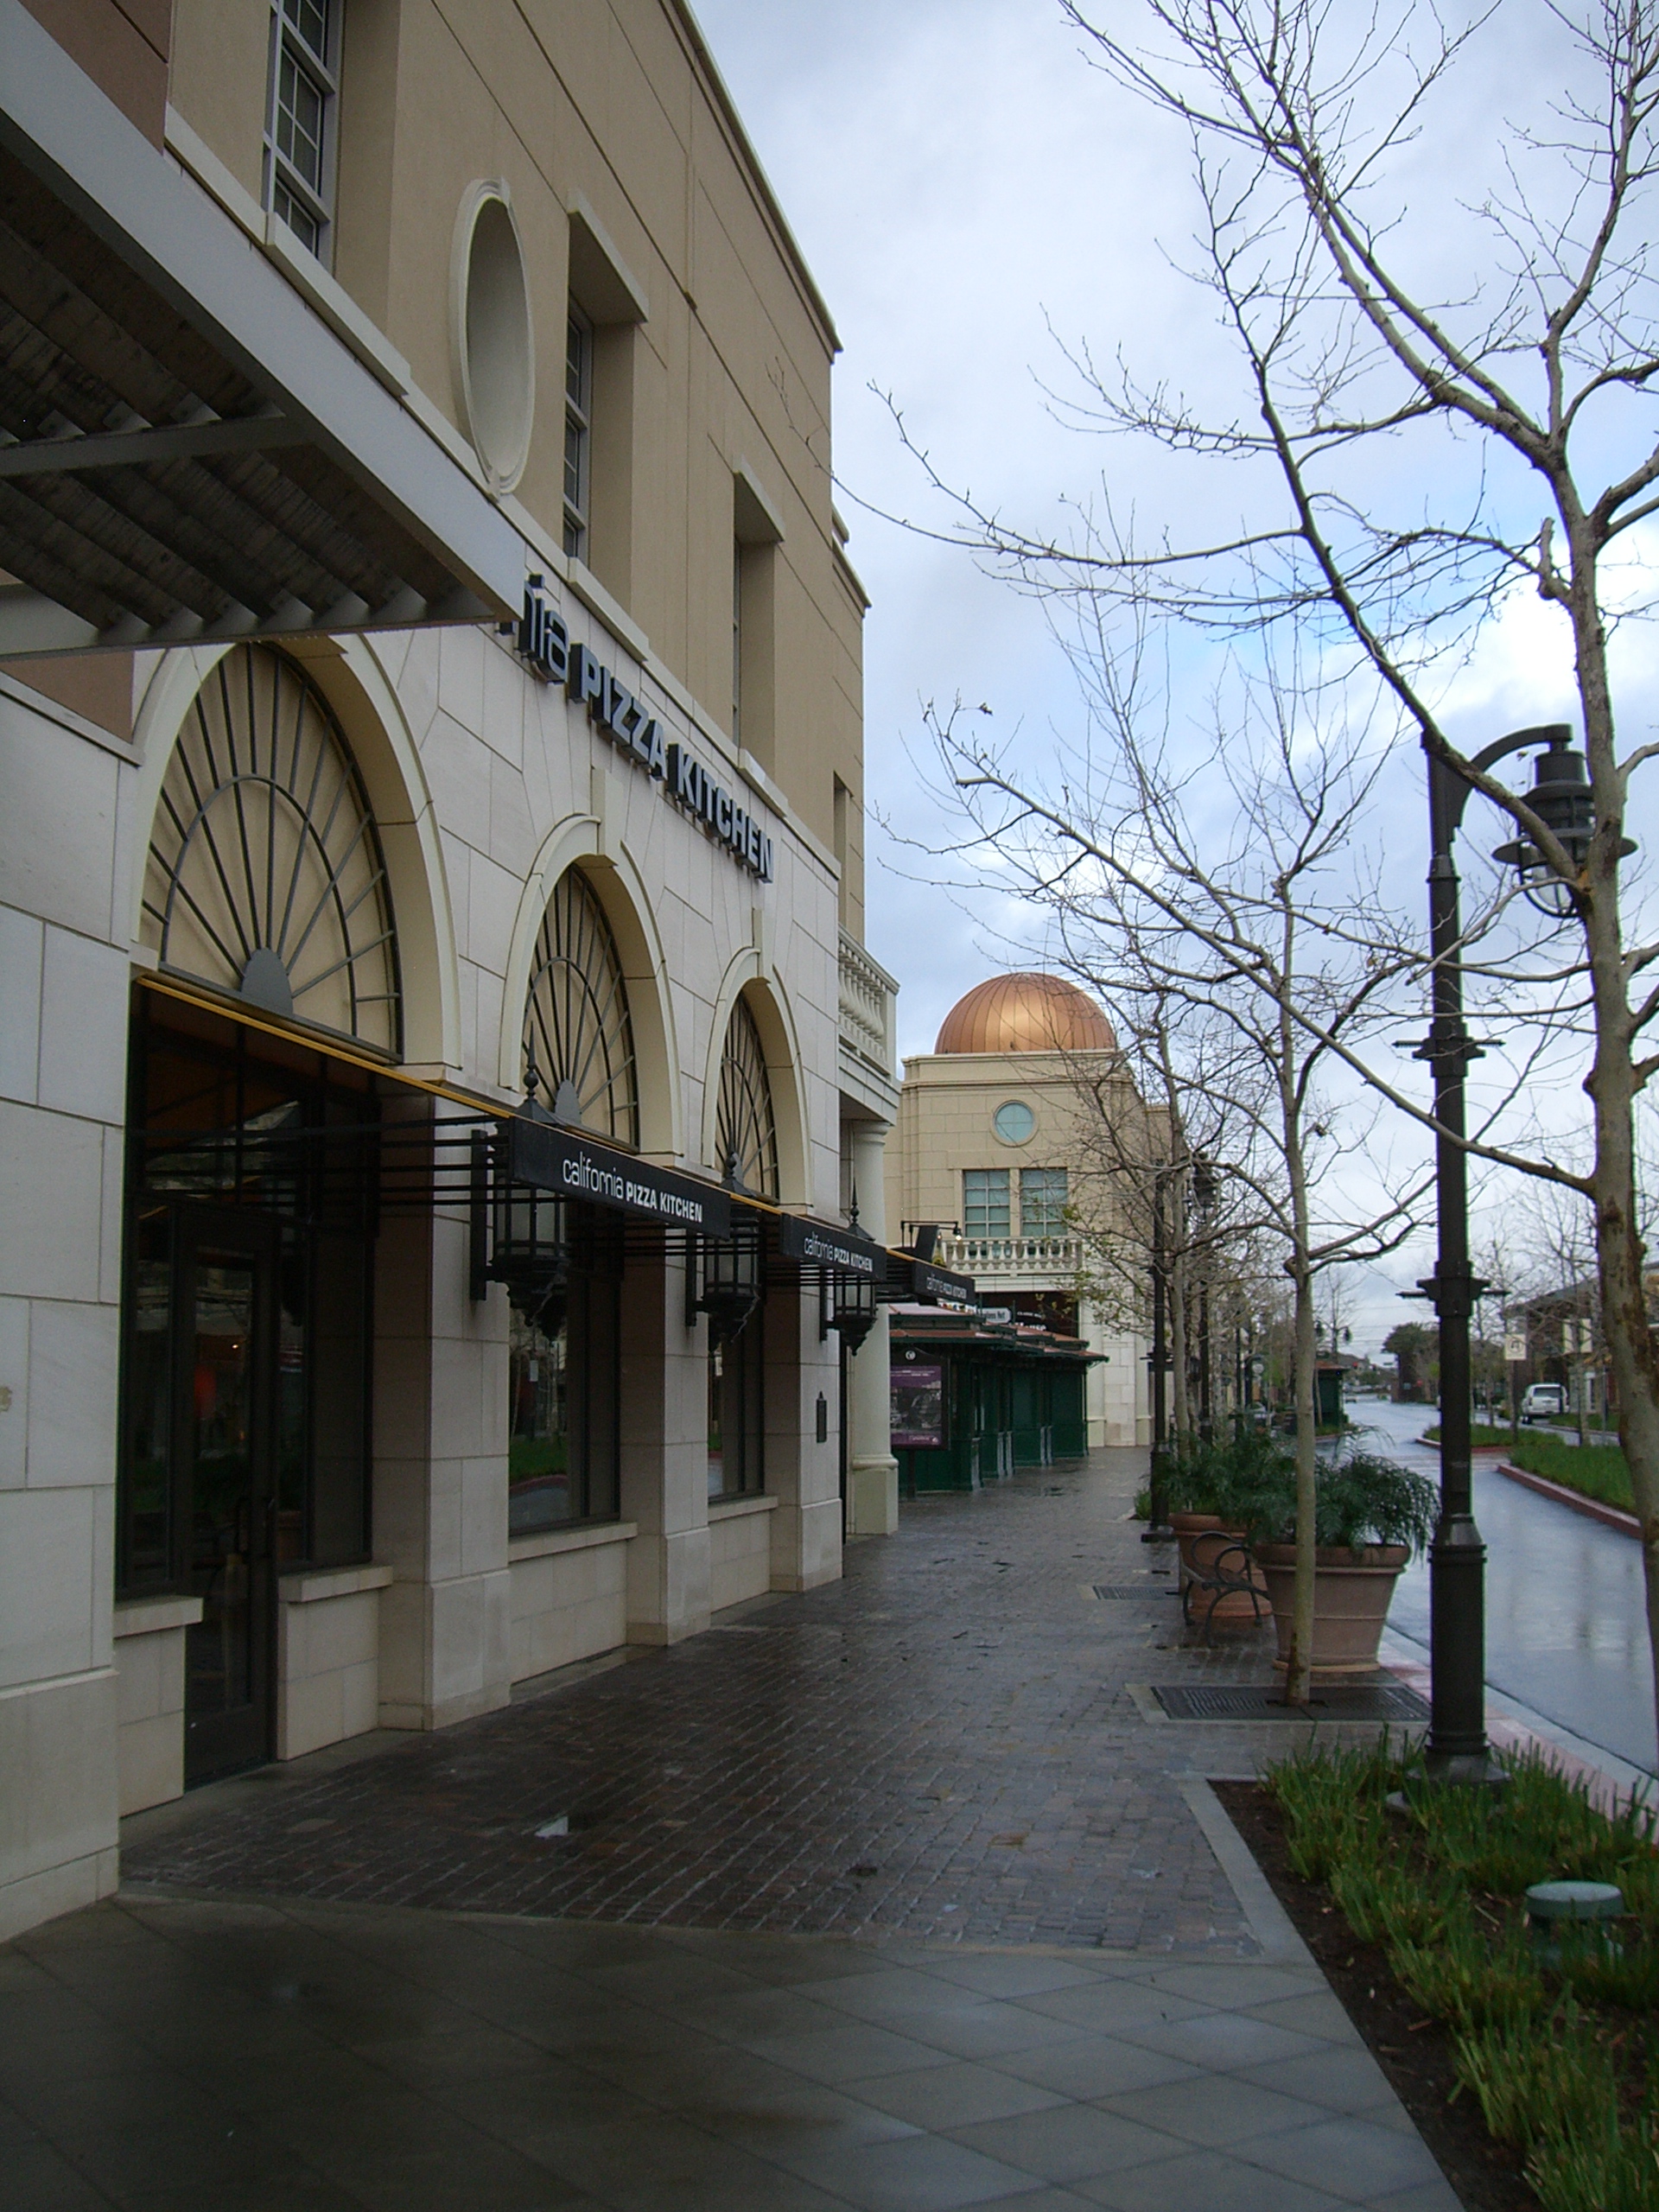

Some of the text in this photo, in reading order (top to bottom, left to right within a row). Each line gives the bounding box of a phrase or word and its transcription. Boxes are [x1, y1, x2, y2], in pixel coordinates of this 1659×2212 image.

[569, 643, 668, 781] PIZZA
[666, 744, 774, 883] KITCHEN
[563, 1151, 703, 1224] california PIZZA KITCHEN
[804, 1231, 873, 1273] california PIZZA KITCHEN
